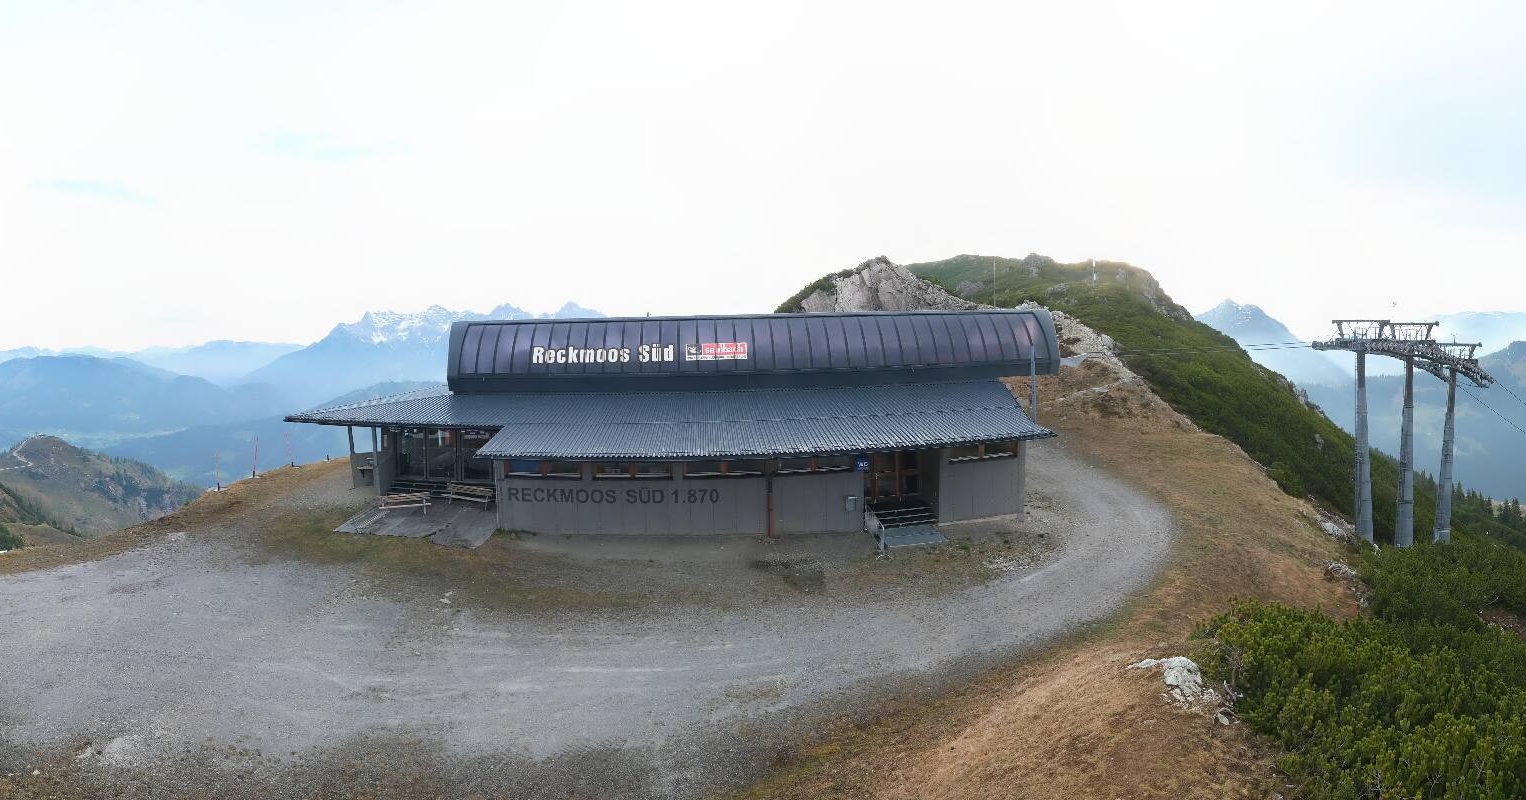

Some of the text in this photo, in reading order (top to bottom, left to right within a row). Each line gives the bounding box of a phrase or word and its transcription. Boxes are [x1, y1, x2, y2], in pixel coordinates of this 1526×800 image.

[532, 344, 674, 363] Reckmoos Süd
[507, 486, 720, 504] RECKMOOS SÜD 1.870
